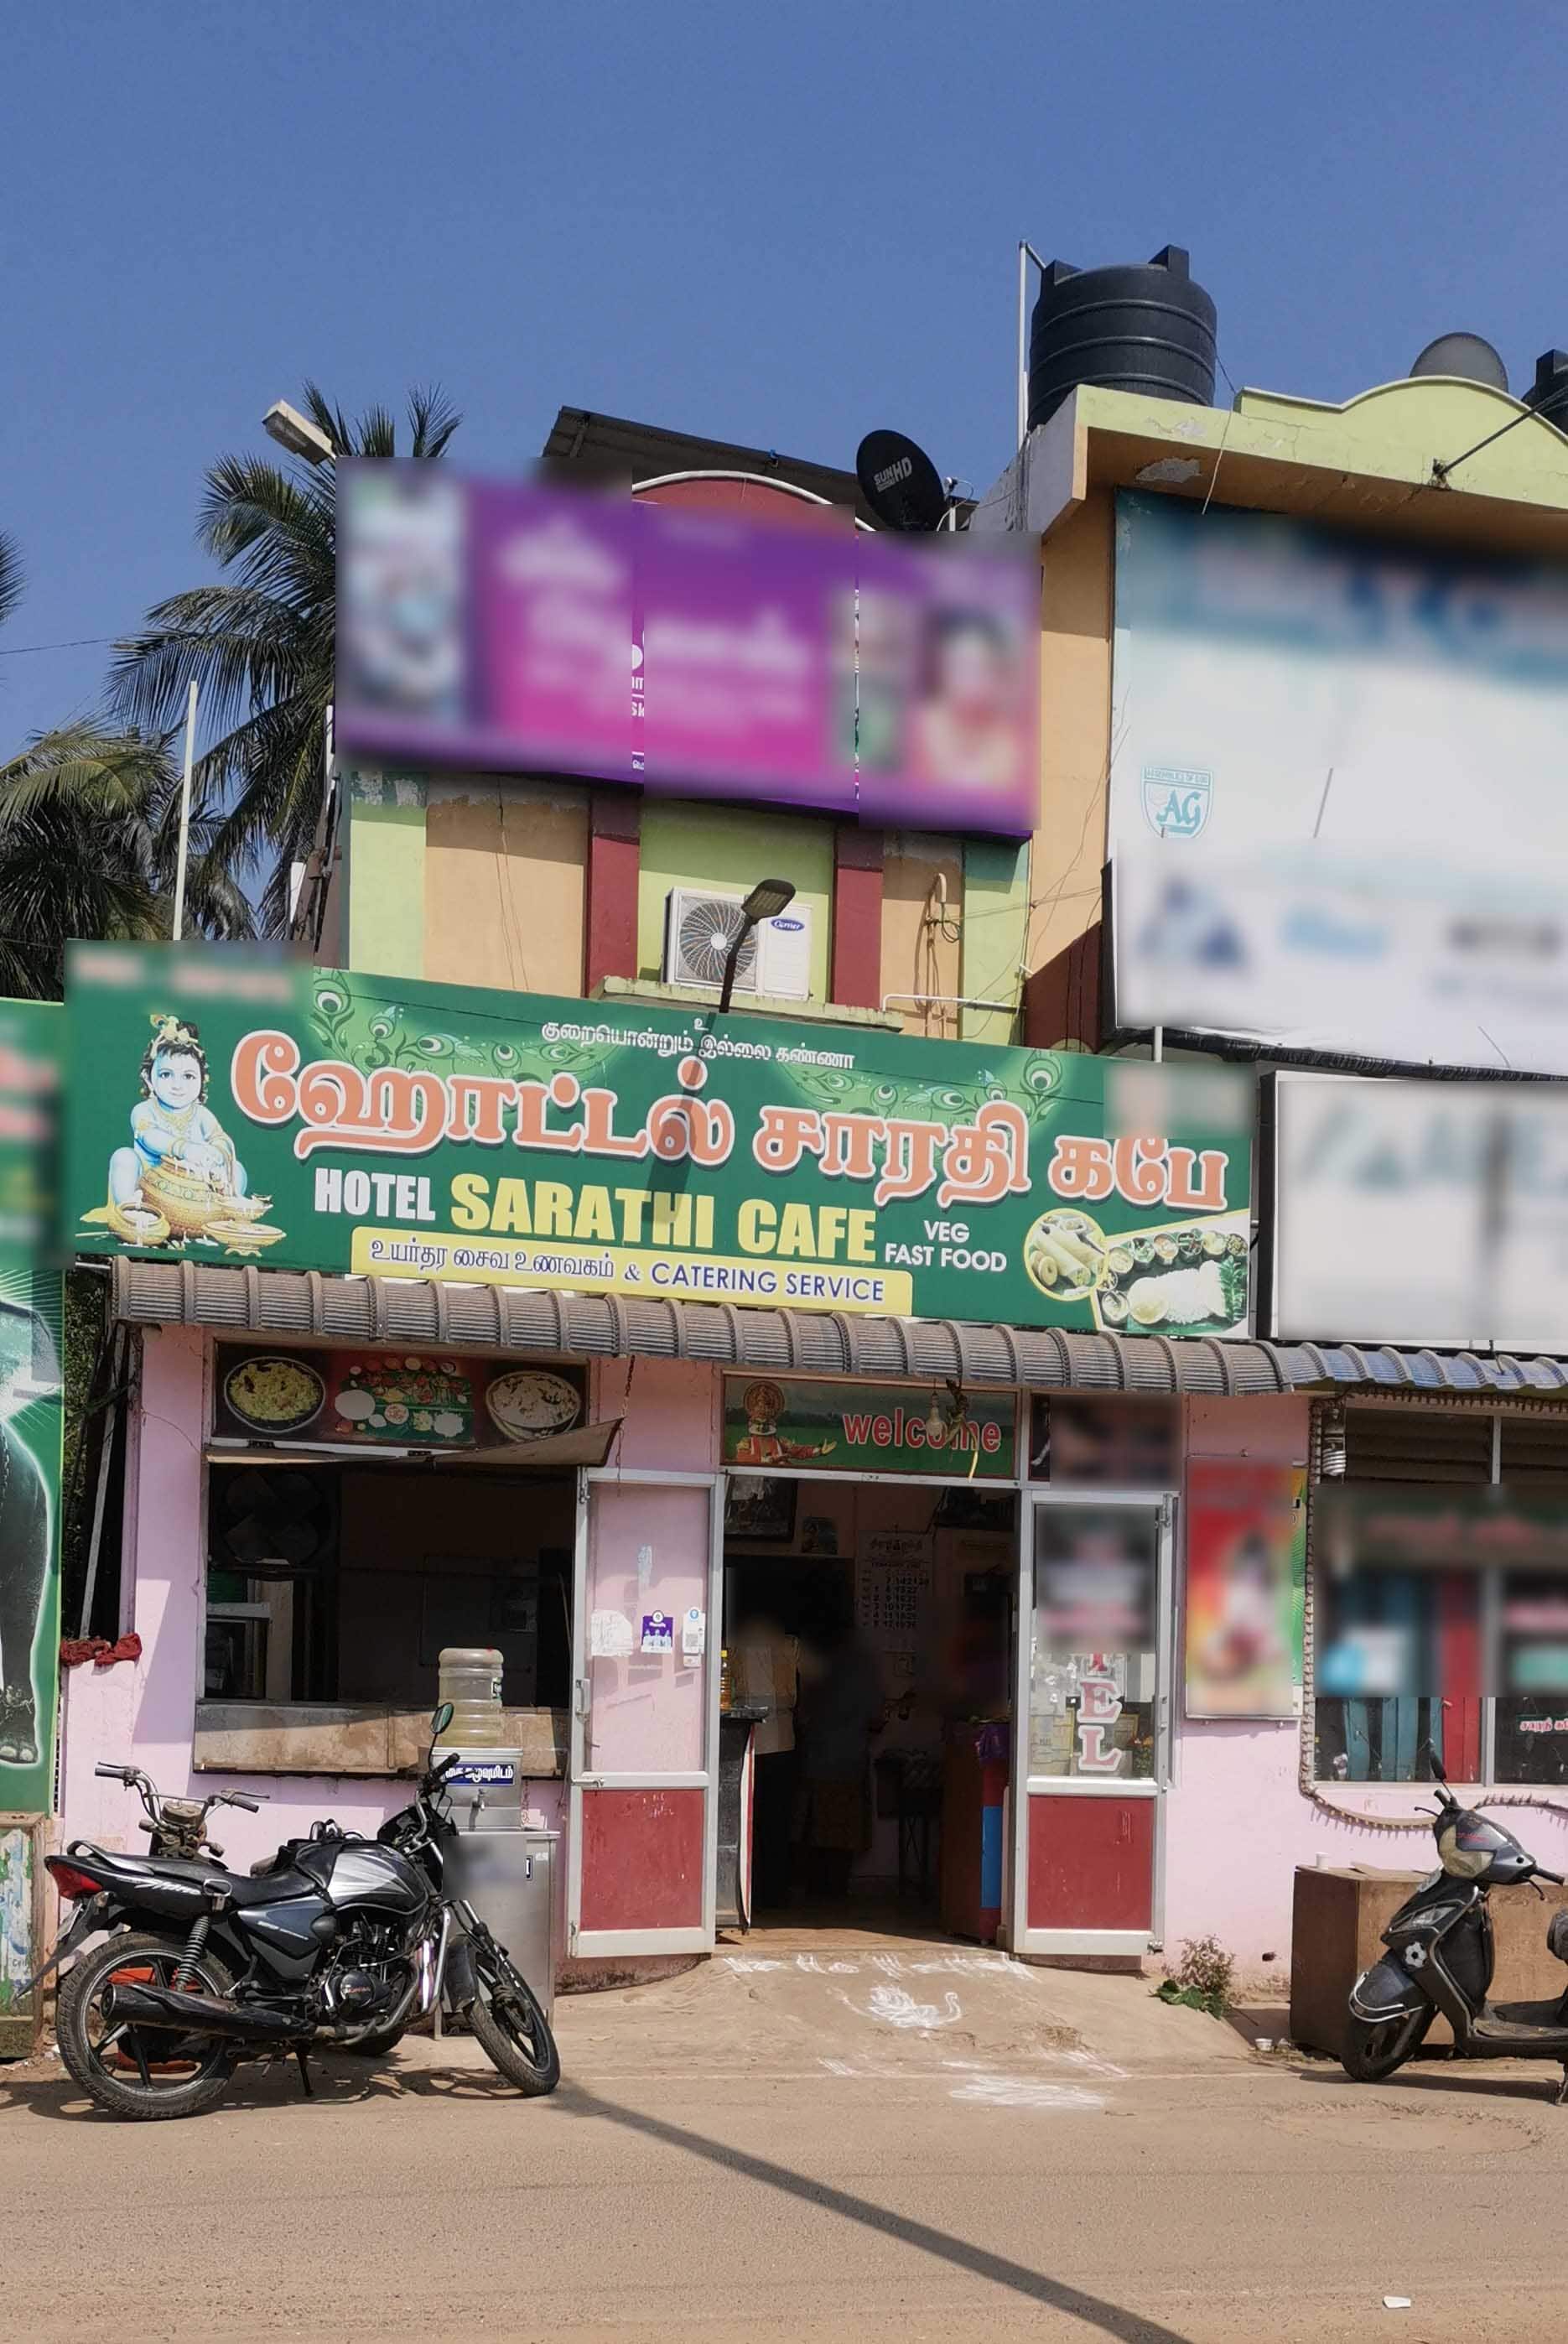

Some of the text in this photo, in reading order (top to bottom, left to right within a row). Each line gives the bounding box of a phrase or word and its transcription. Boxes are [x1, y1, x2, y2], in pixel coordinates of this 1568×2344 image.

[1156, 789, 1201, 834] AG
[231, 1030, 1229, 1211] ஹோட்டல் சாரதி கபே
[314, 1167, 876, 1262] HOTEL SARATHI CAFE
[923, 1220, 970, 1243] VEG
[371, 1236, 885, 1302] உயர்தர சைவ உணவகம் & CATERING SERVICE
[885, 1242, 1007, 1272] FAST FOOD
[843, 1407, 1001, 1453] welcome
